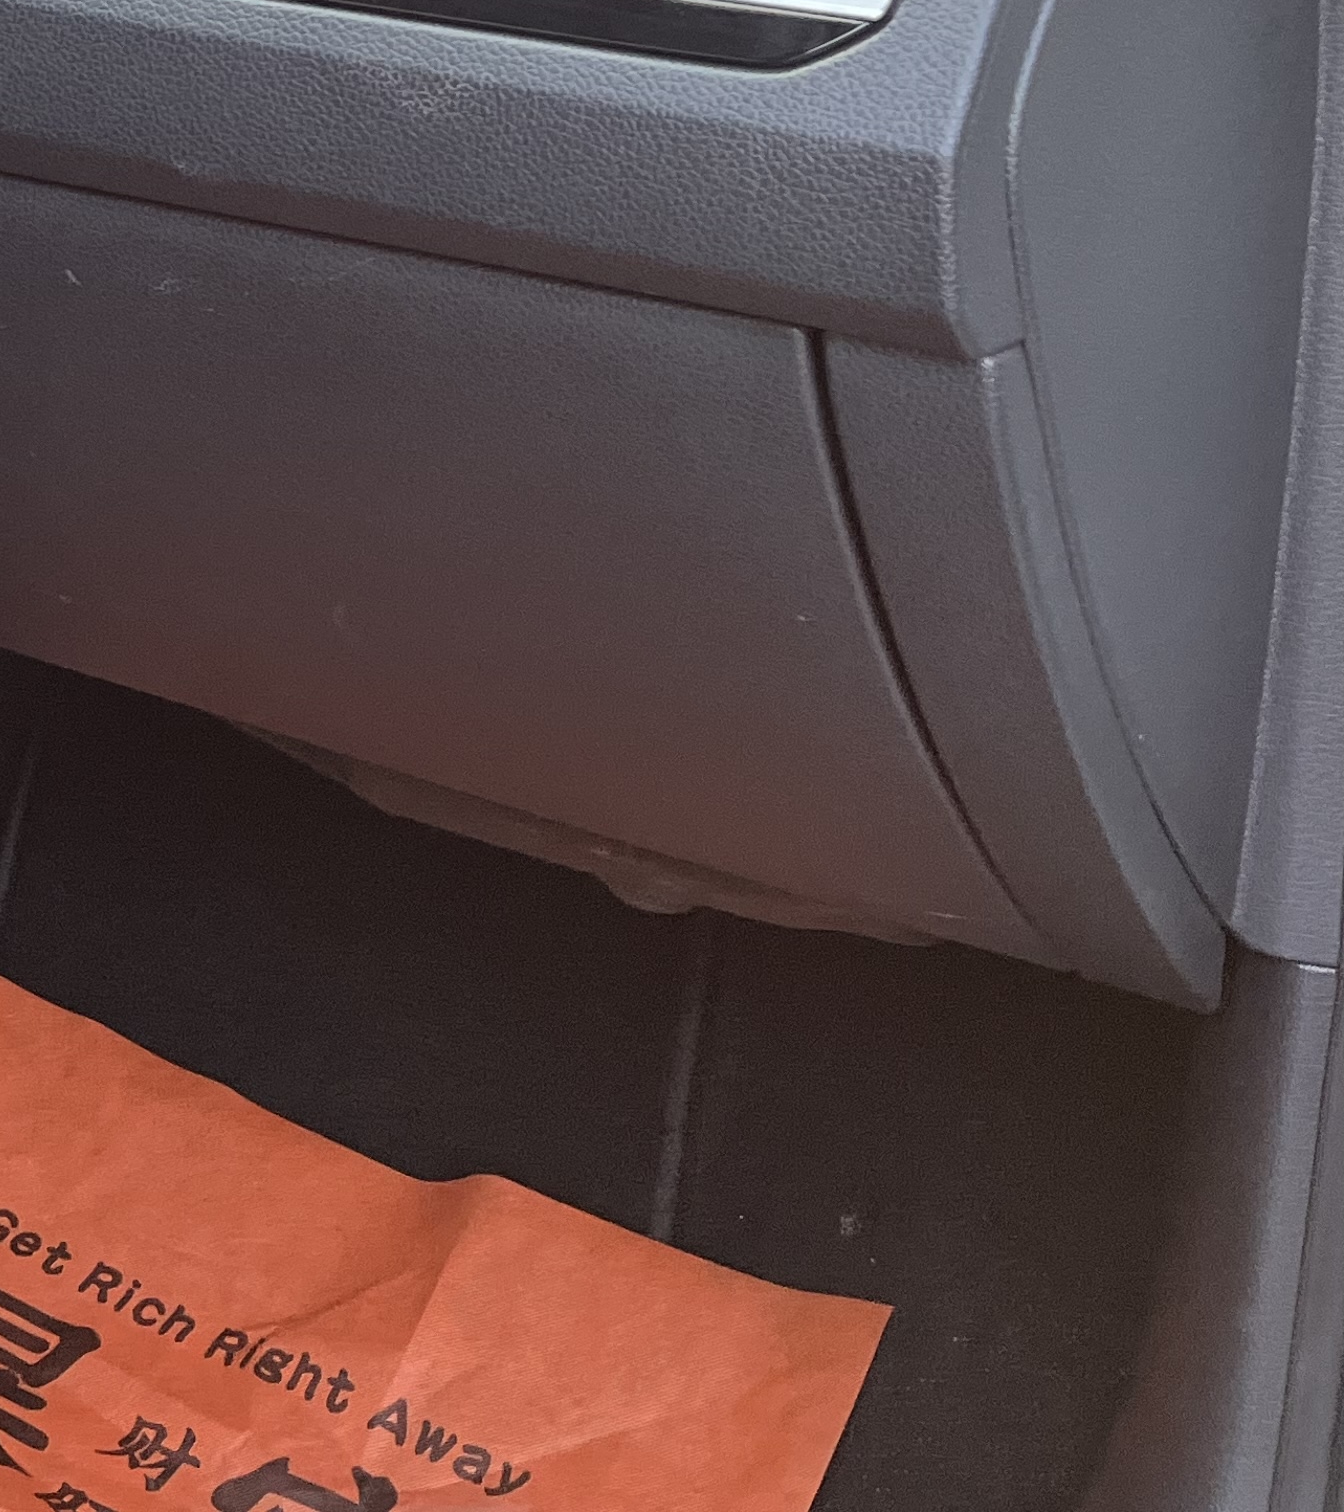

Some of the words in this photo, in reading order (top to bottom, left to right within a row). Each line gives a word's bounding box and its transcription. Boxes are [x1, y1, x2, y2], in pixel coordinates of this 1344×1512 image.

[78, 1261, 196, 1343] Rich
[204, 1326, 355, 1414] Right
[367, 1398, 532, 1497] Away
[95, 1415, 202, 1492] 财
